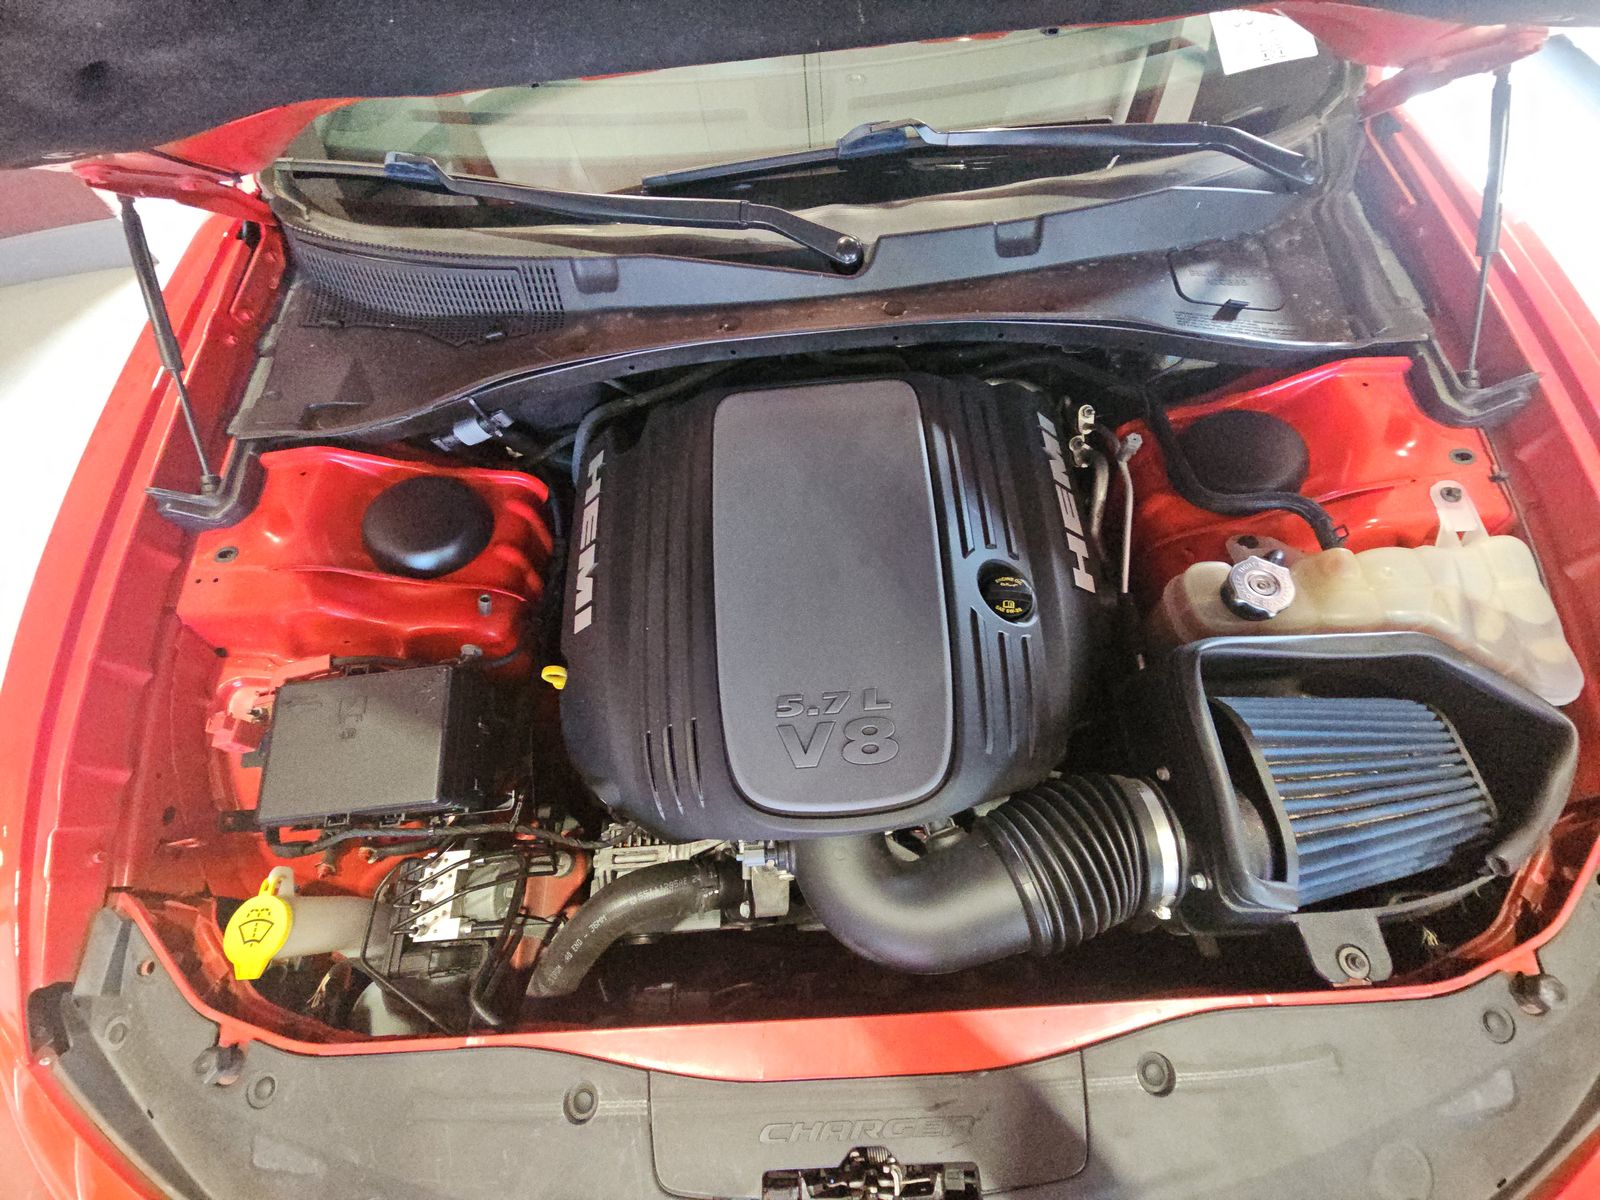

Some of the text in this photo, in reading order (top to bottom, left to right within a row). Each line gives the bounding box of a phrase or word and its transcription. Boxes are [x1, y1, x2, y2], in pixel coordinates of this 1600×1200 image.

[573, 450, 606, 635] HEMI
[1037, 411, 1096, 594] HEMI
[776, 716, 899, 769] V8
[759, 1115, 977, 1144] CHARGER
